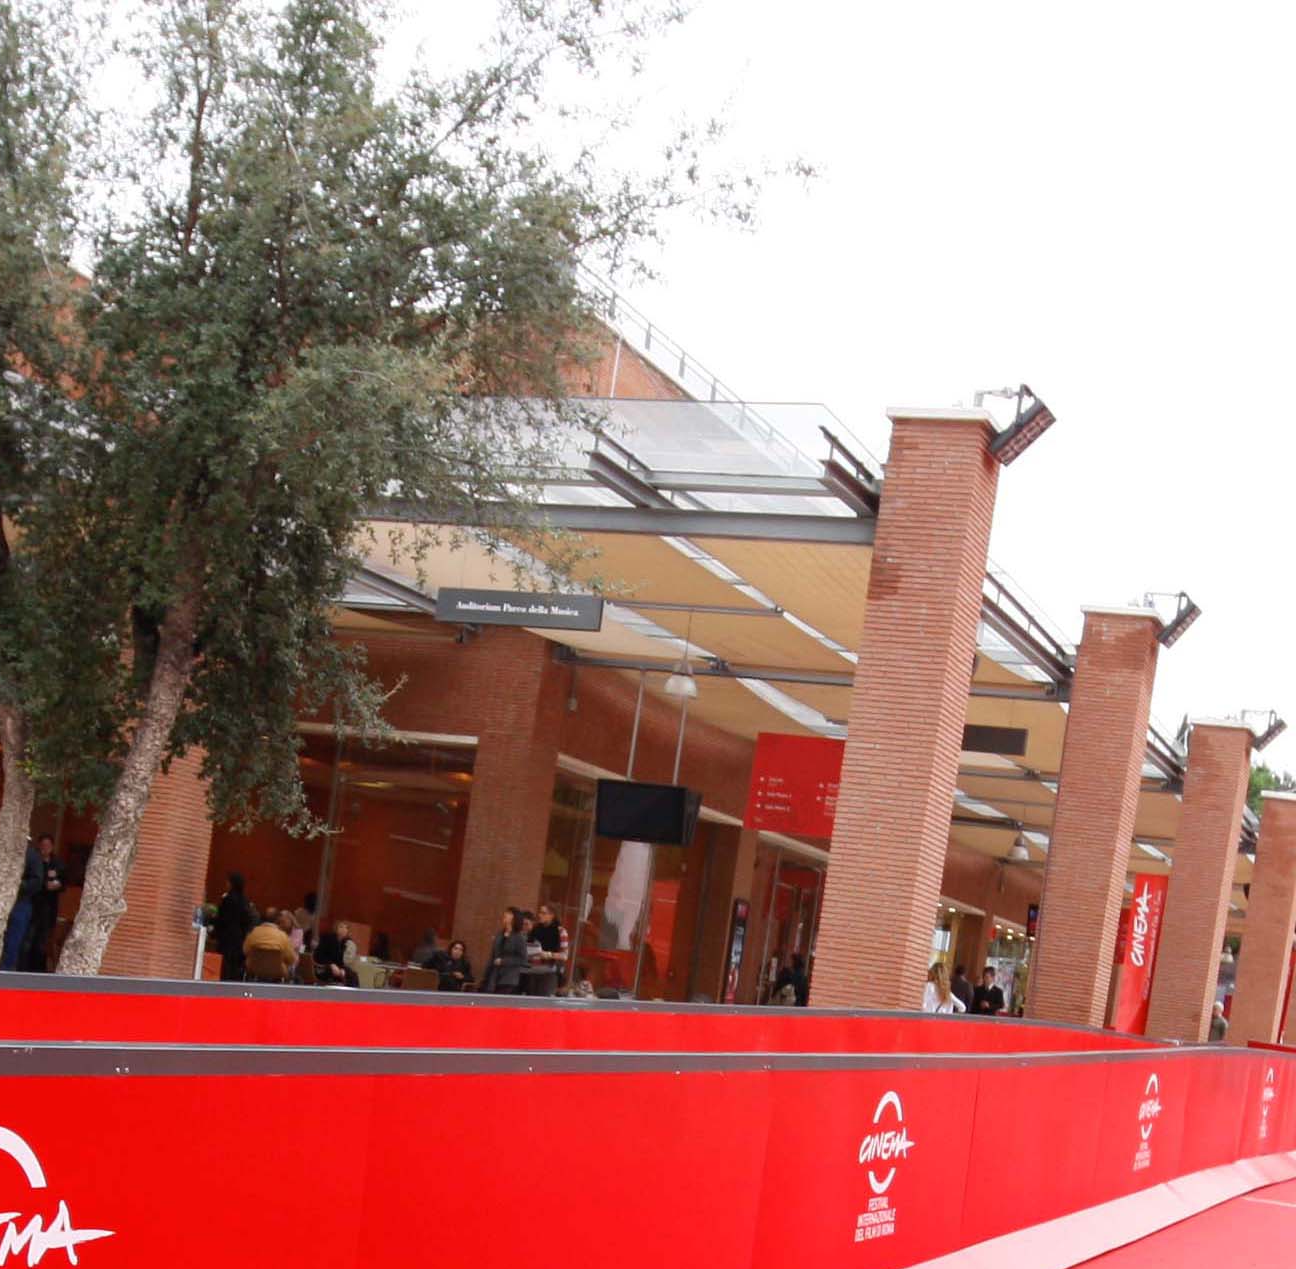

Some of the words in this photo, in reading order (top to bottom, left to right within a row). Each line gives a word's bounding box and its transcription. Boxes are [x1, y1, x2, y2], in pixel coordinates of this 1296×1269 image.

[456, 601, 501, 612] Auditorium
[503, 603, 526, 613] Parco
[528, 604, 548, 615] della
[550, 606, 579, 617] Musica
[1130, 880, 1152, 967] CINEMA
[858, 1127, 916, 1164] CINEMA
